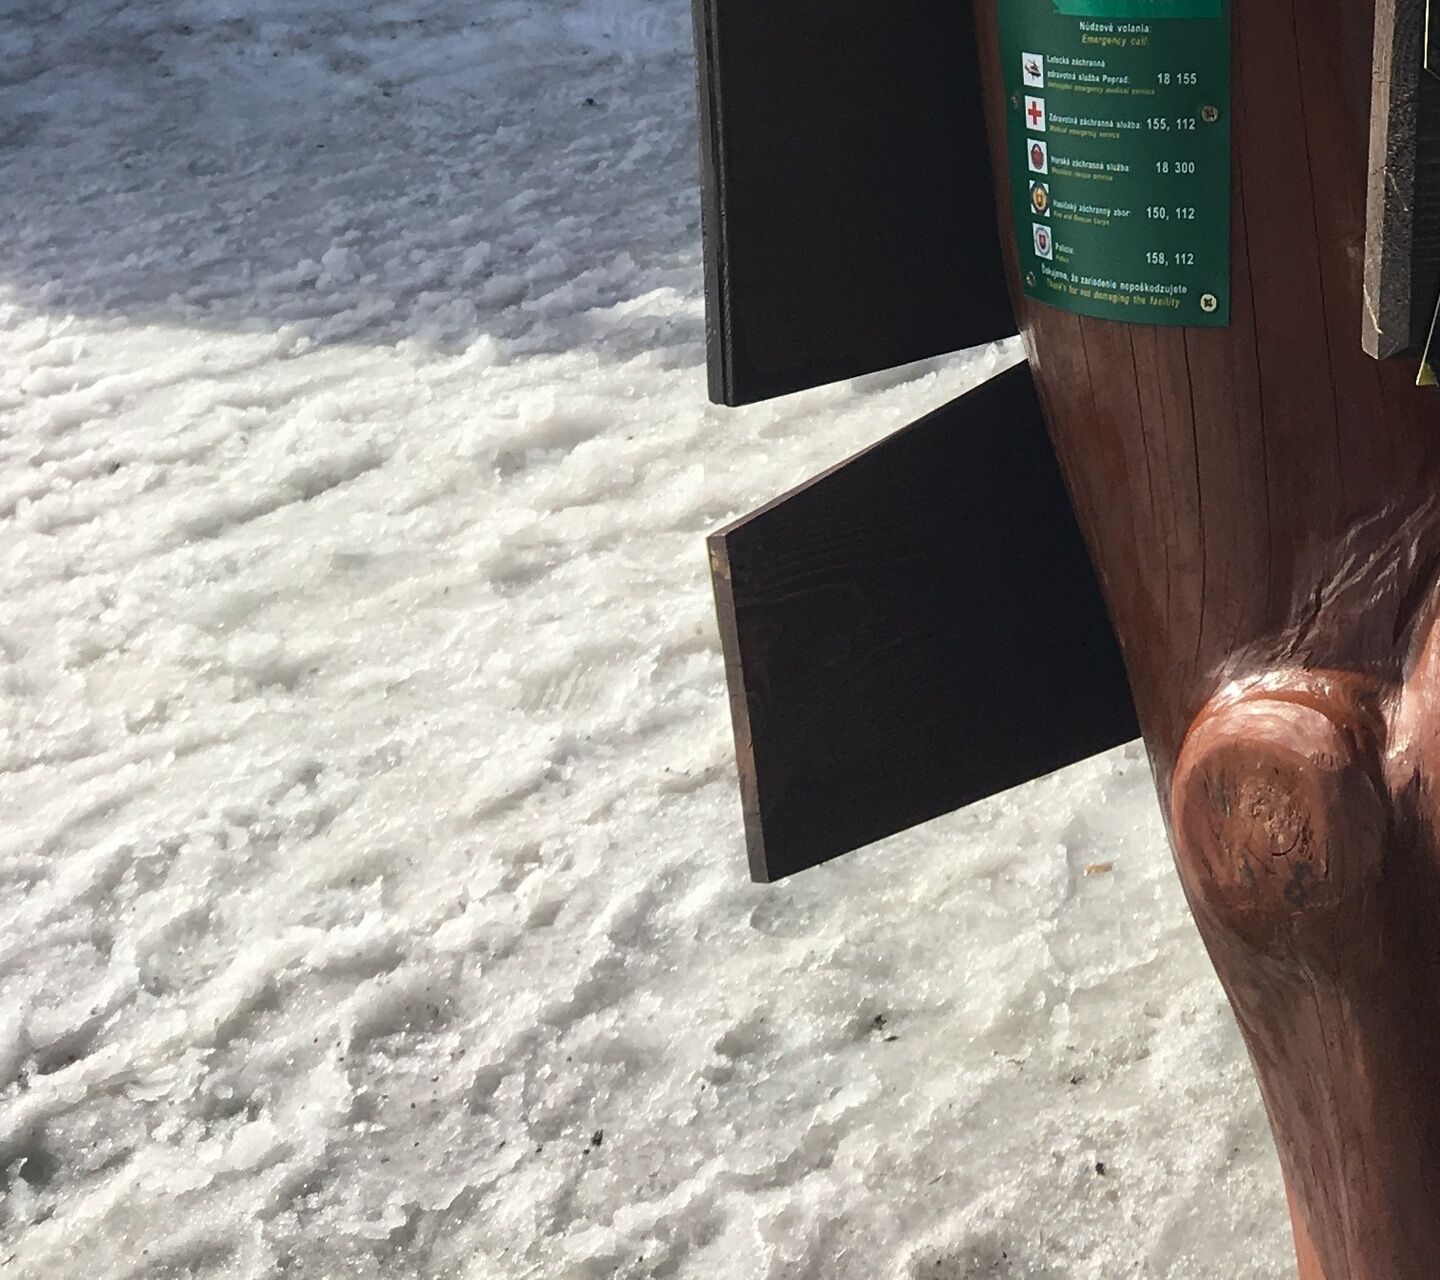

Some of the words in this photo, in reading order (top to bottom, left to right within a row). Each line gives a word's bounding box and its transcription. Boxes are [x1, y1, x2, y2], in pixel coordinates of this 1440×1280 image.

[1079, 21, 1114, 32] Núdzové
[1157, 72, 1171, 85] 18
[1176, 72, 1197, 85] 155
[1146, 117, 1170, 131] 155,
[1176, 118, 1196, 131] 112
[1155, 161, 1169, 174] 18
[1174, 161, 1195, 174] 300
[1146, 206, 1170, 220] 150,
[1175, 207, 1195, 219] 112
[1145, 251, 1169, 266] 158,
[1174, 253, 1194, 265] 112
